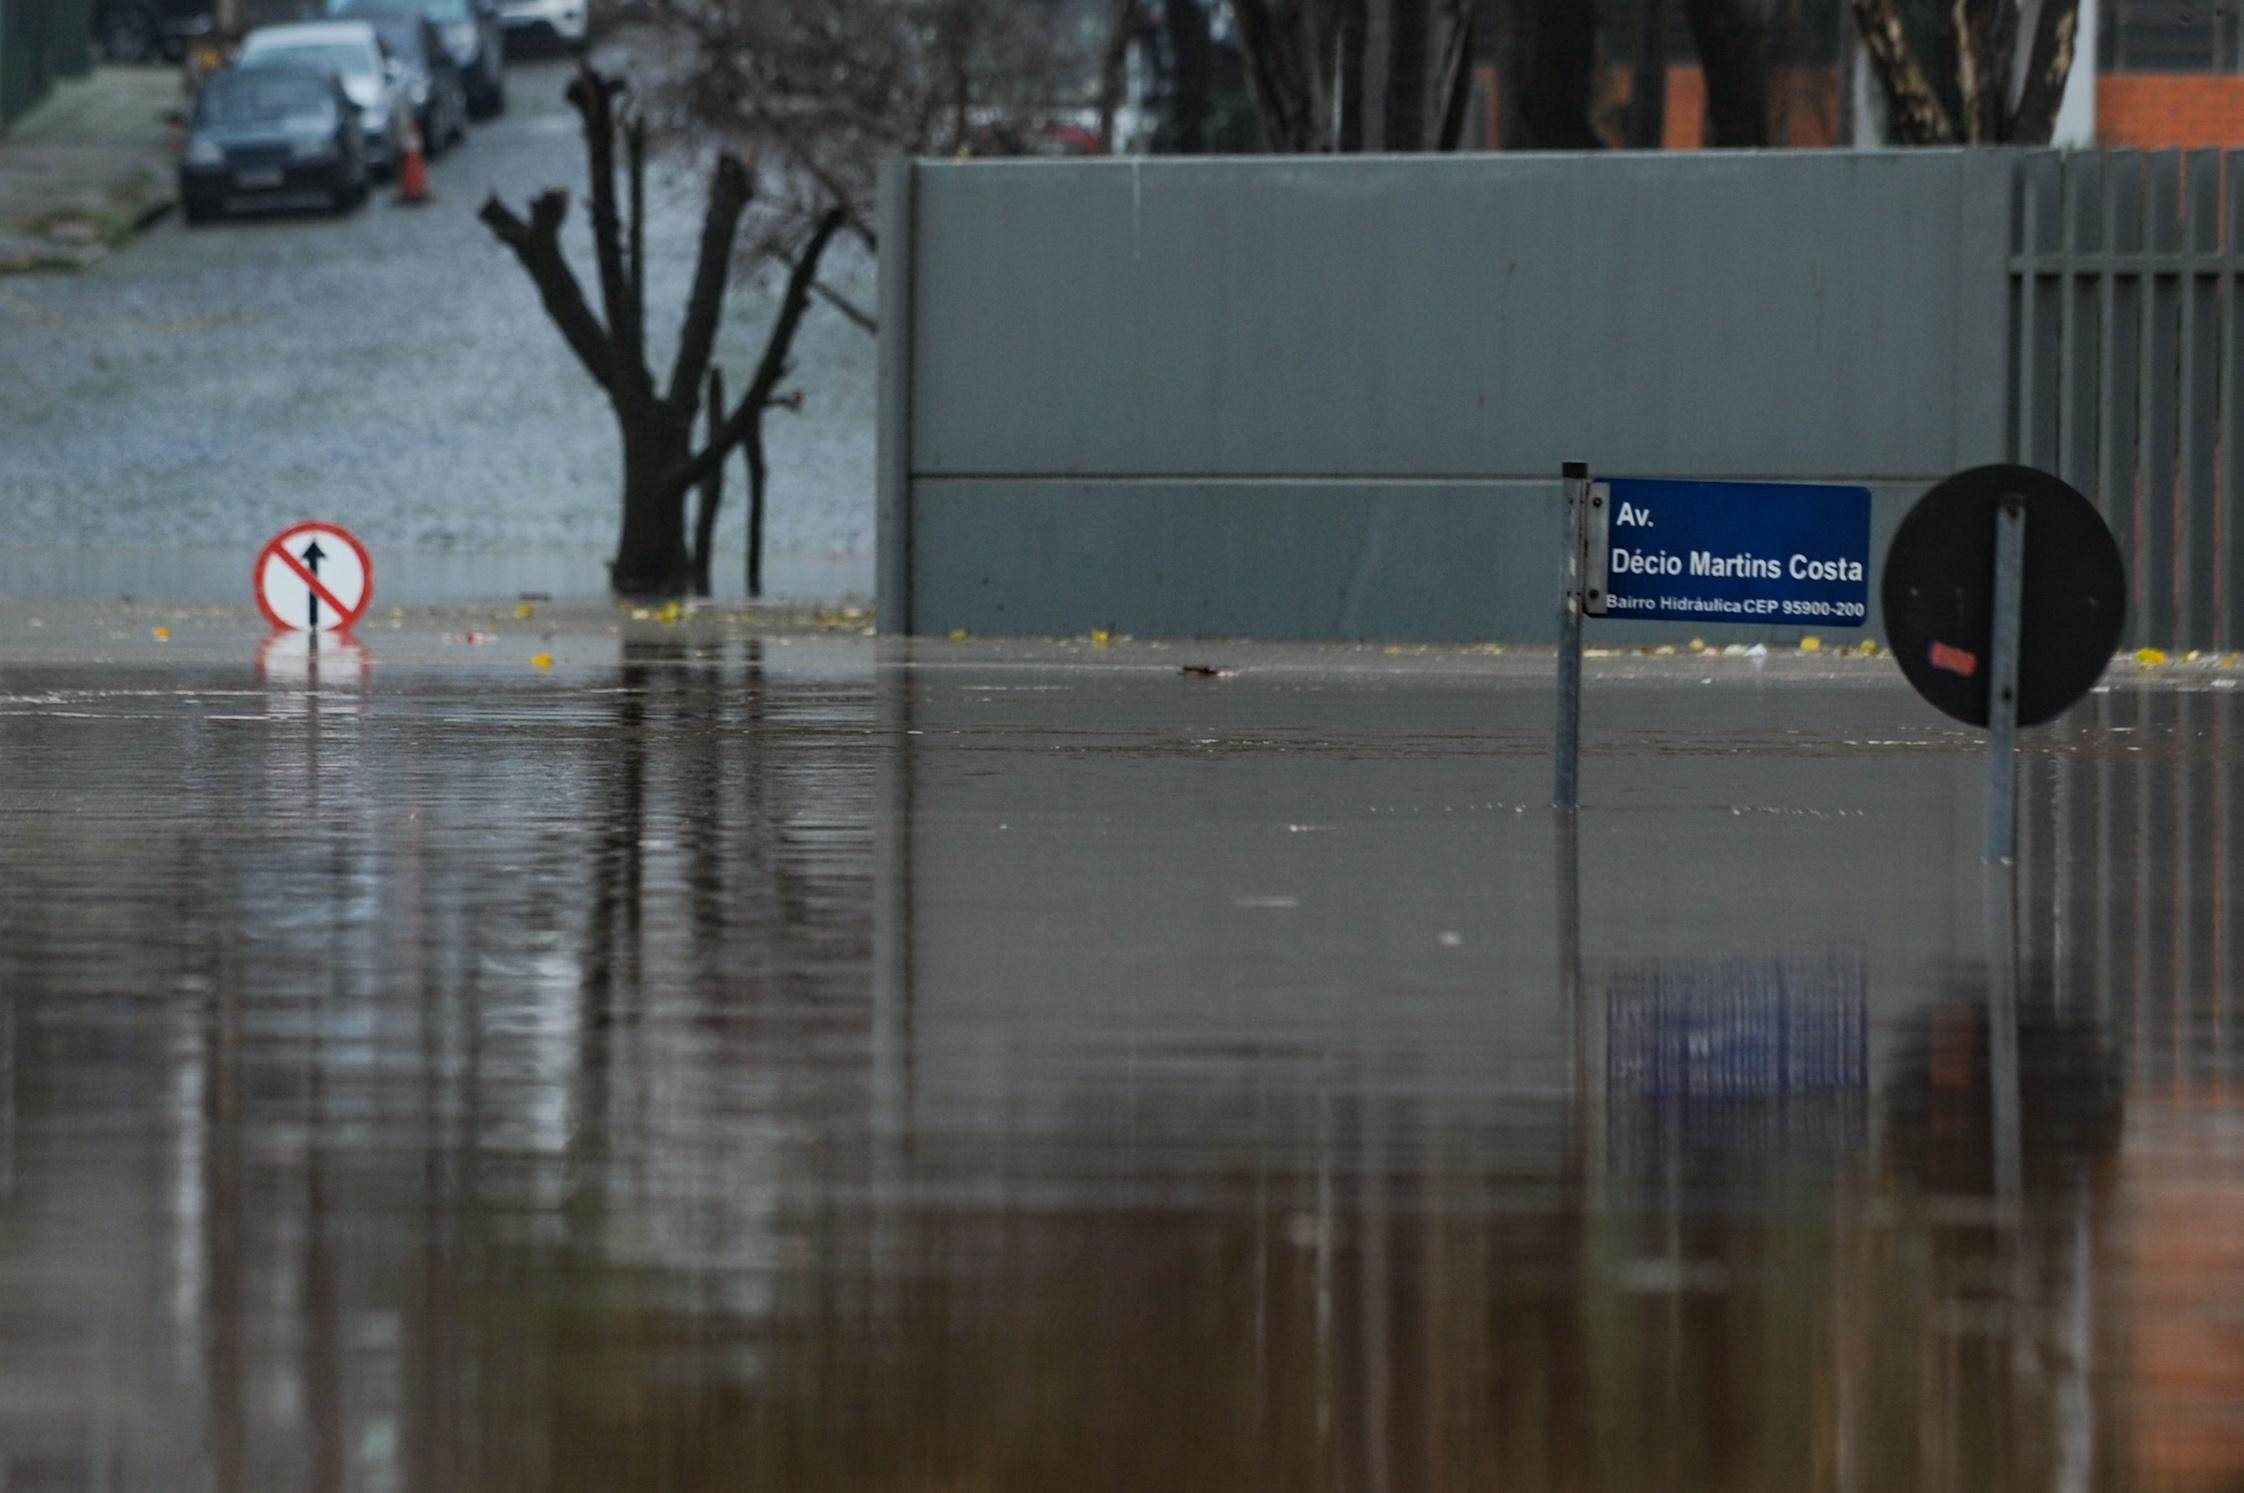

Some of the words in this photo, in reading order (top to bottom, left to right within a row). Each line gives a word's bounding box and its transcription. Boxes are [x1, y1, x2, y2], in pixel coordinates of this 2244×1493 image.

[1616, 501, 1654, 528] Av.
[1612, 548, 1682, 575] Décio
[1689, 551, 1782, 579] Martins
[1788, 554, 1863, 582] Costa
[1606, 594, 1656, 610] Bairro
[1744, 598, 1777, 614] CEP
[1782, 600, 1864, 617] 95900-200
